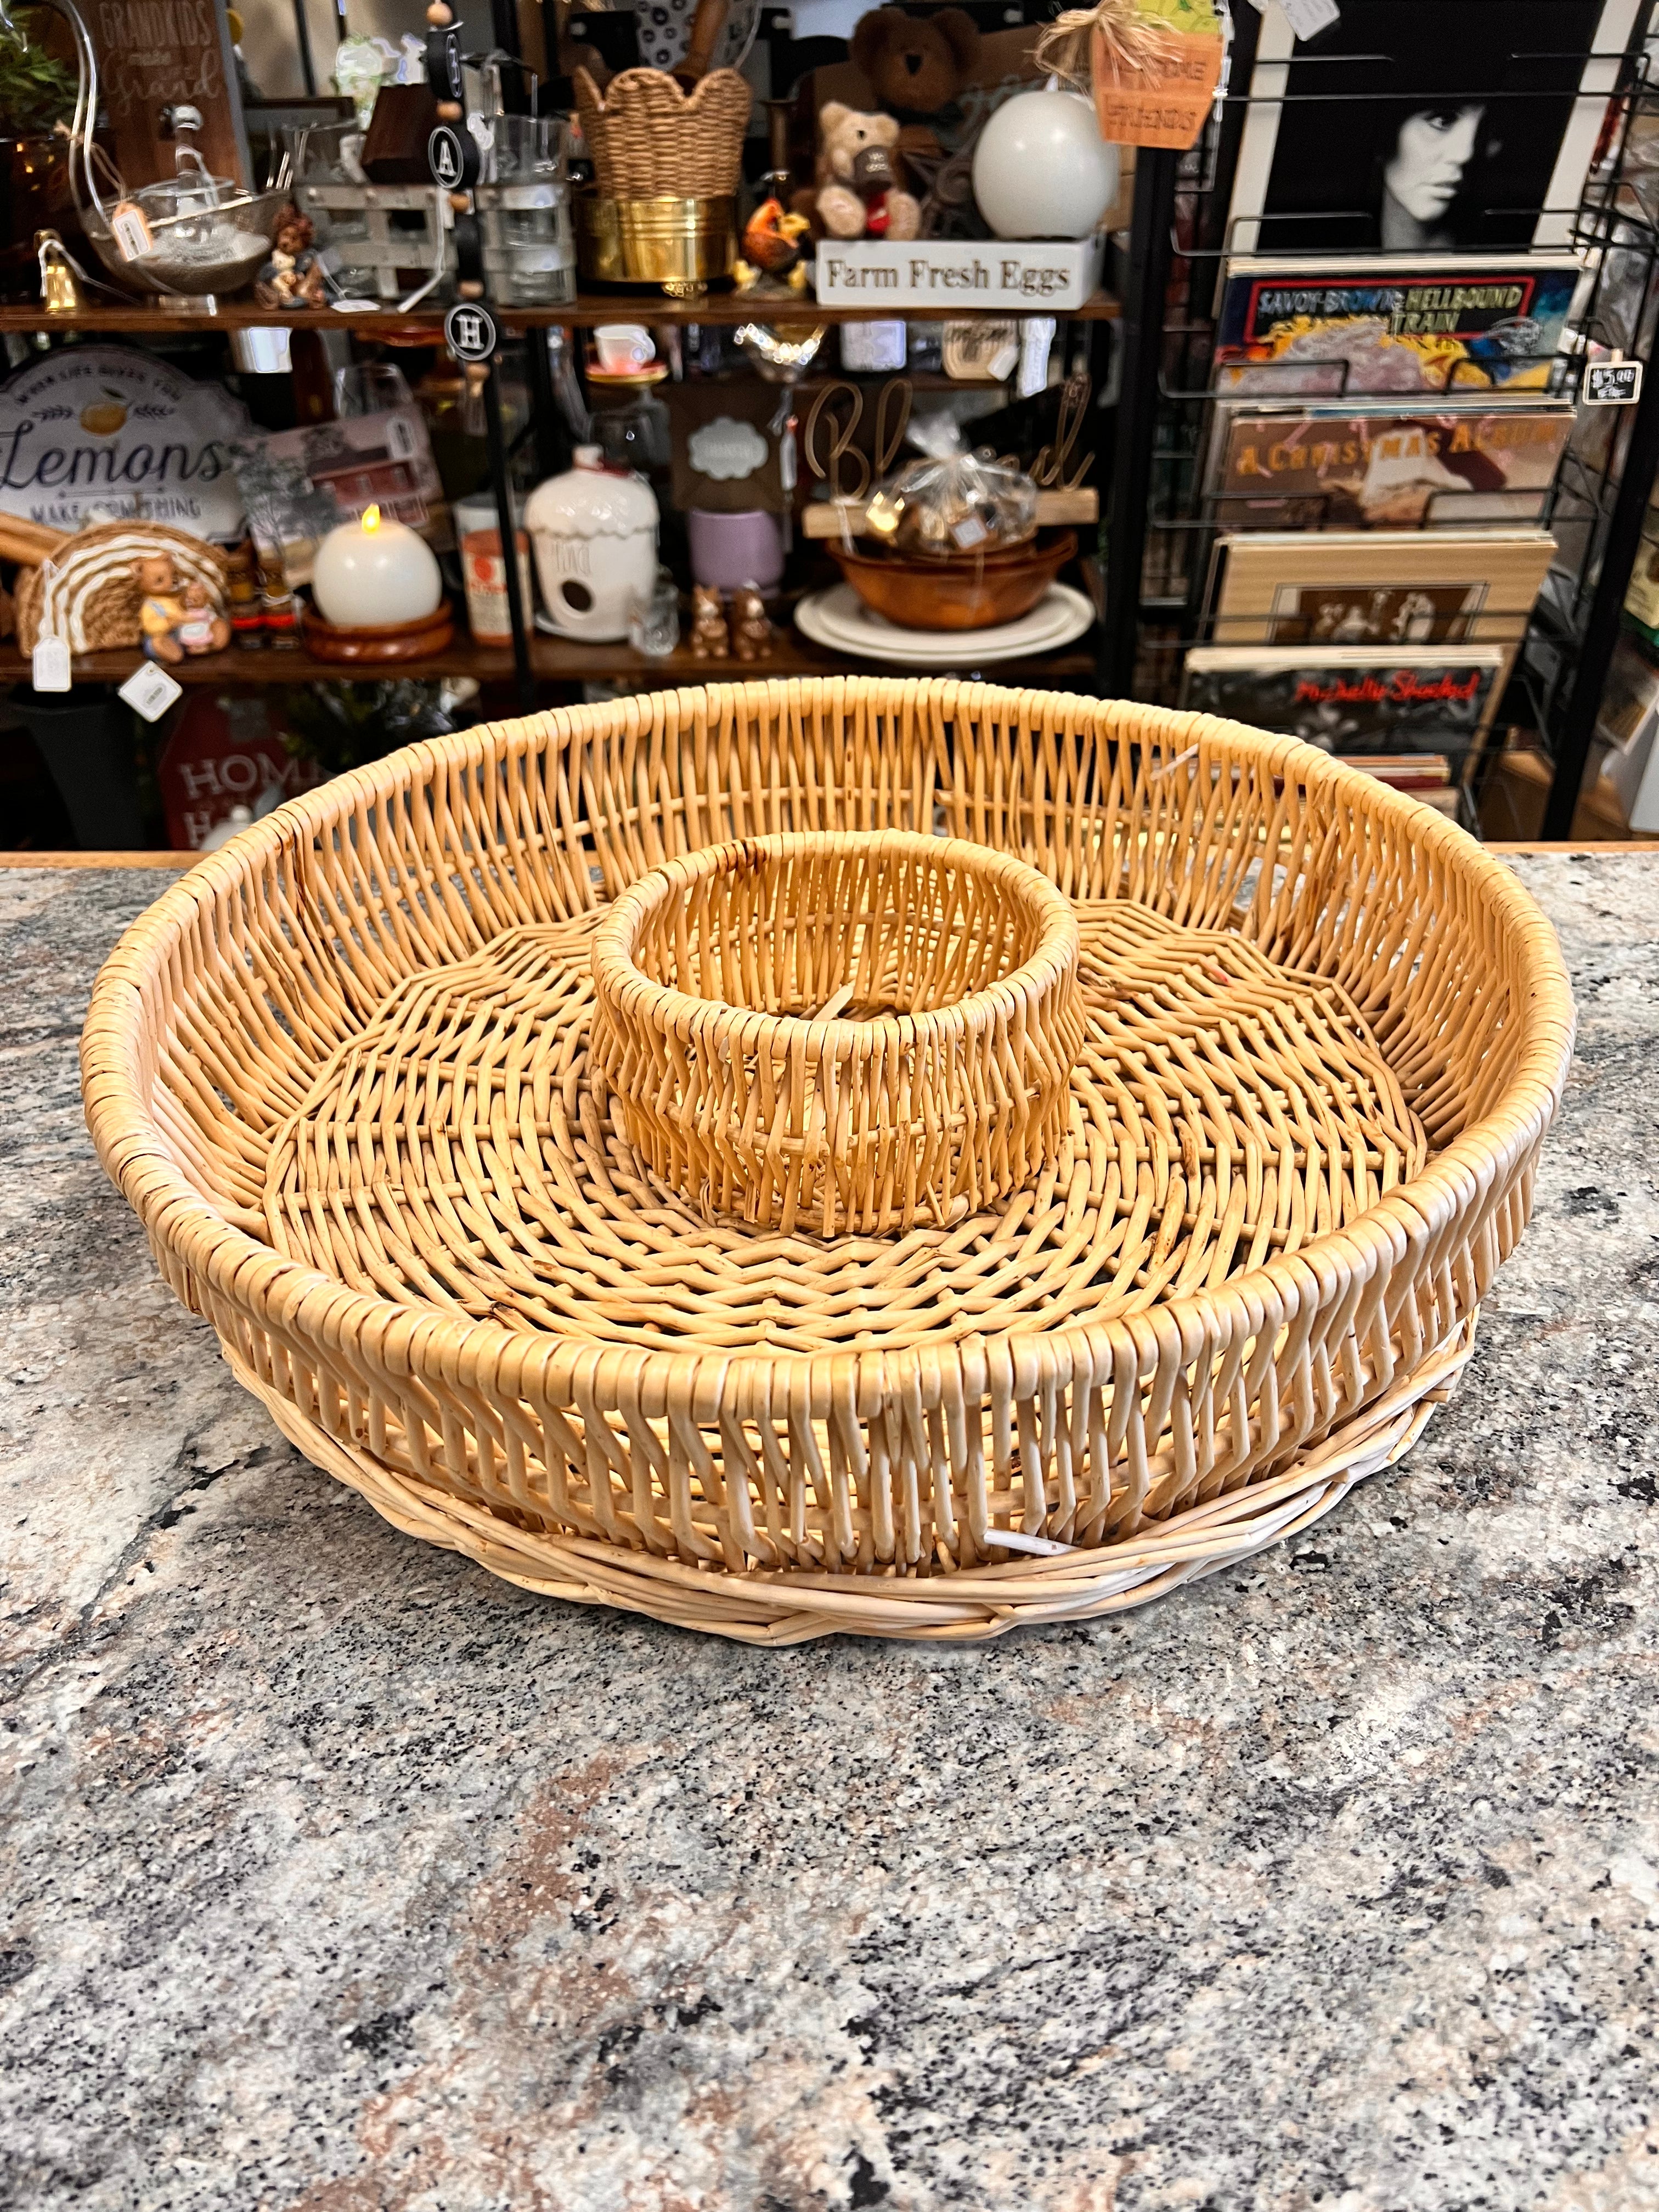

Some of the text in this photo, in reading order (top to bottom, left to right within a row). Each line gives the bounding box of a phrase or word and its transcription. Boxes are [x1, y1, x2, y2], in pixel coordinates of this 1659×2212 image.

[826, 258, 1071, 297] Farm Fresh Eggs
[1259, 285, 1523, 317] SAVOY BROWN HELLBOUND
[456, 315, 484, 351] H
[1389, 309, 1463, 336] TRAIN
[2, 419, 224, 489] Lemons
